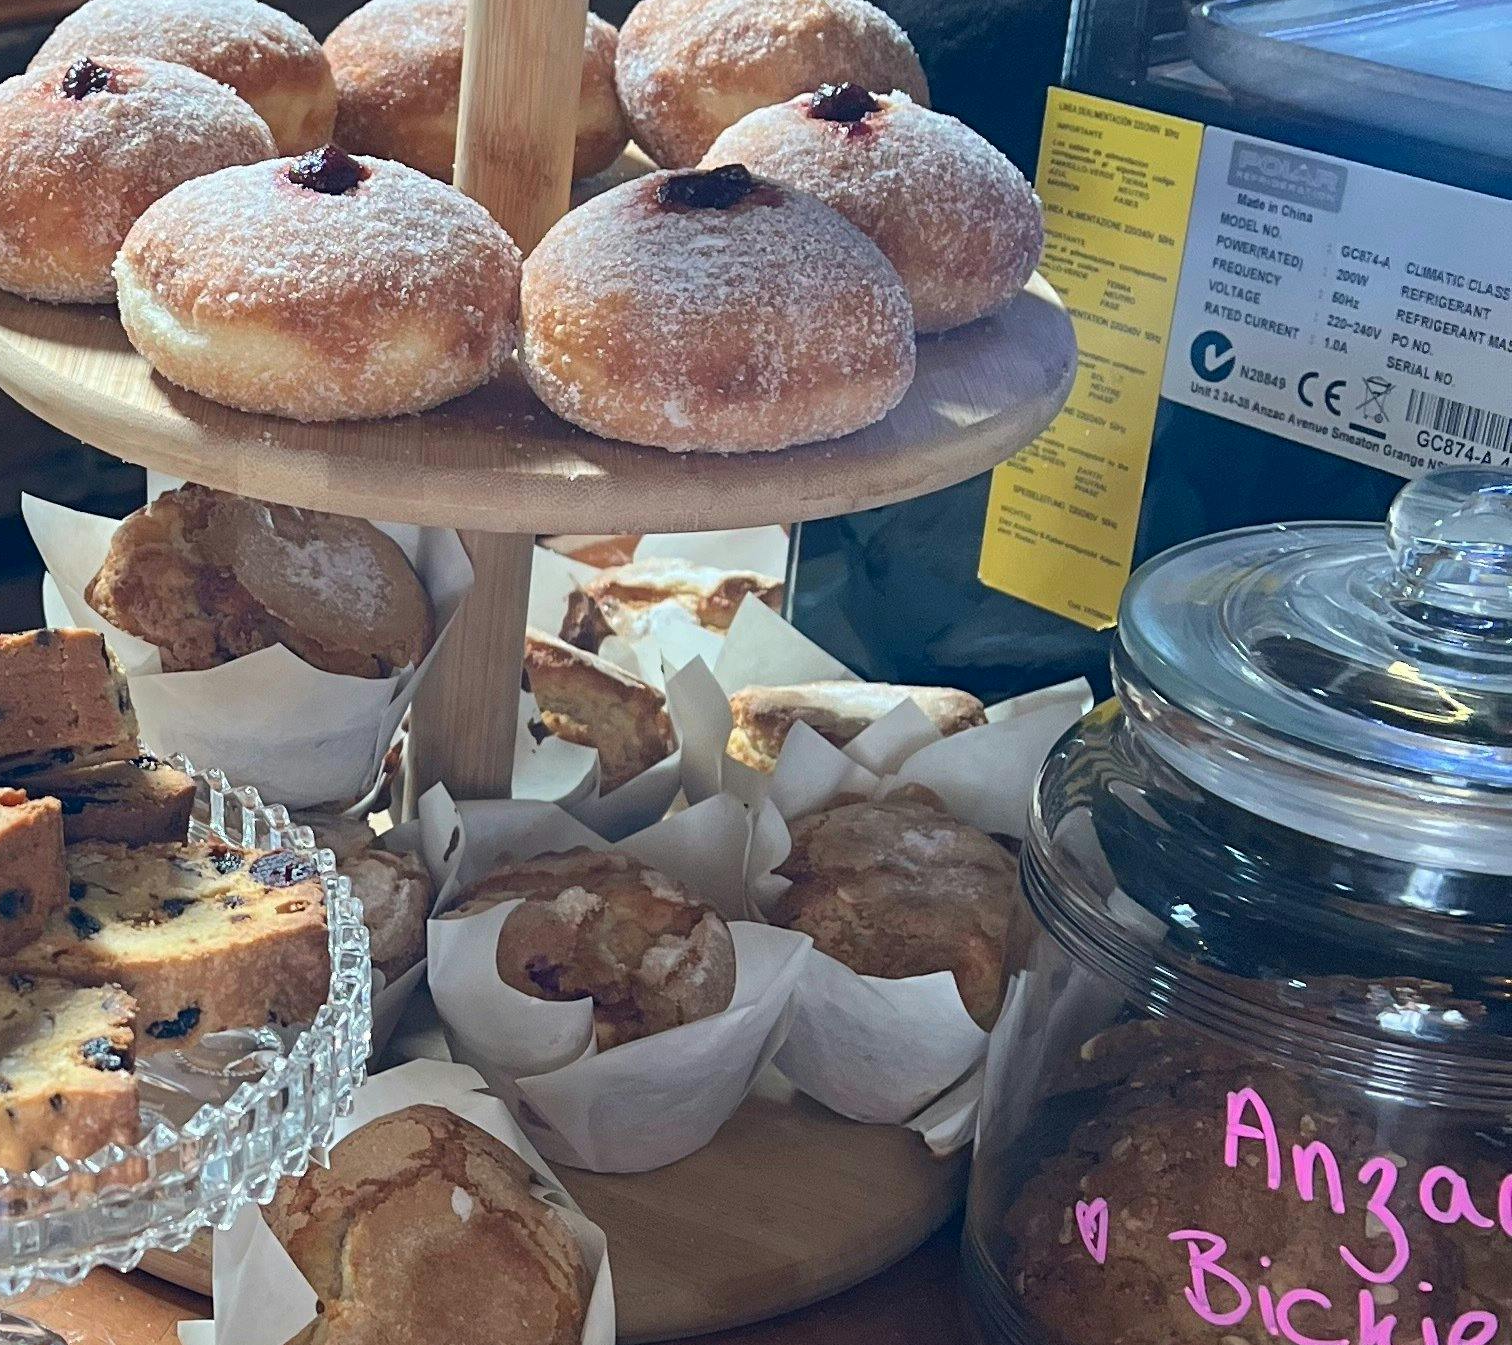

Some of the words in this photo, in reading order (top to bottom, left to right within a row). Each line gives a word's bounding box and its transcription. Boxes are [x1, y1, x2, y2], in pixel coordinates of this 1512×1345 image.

[1237, 193, 1265, 210] Made
[1268, 202, 1277, 213] in
[1282, 205, 1313, 223] China
[1216, 234, 1304, 272] POWER(RATED)
[1400, 285, 1492, 320] REFRIGERANT
[1220, 212, 1258, 233] MODEL
[1342, 246, 1390, 269] GC874-A
[1406, 262, 1465, 288] CLIMATIC
[1468, 278, 1511, 301] CLASS
[1203, 300, 1242, 323] RATED
[1243, 312, 1300, 340] CURRENT
[1386, 355, 1430, 380] SERIAL
[1209, 278, 1262, 305] VOLTAGE
[1390, 332, 1409, 348] PO
[1212, 257, 1283, 287] FREQUENCY
[1395, 308, 1486, 345] REFRIGERANT
[1190, 380, 1210, 396] Unit
[1287, 413, 1329, 435] Avenue
[1331, 426, 1380, 453] Smeaton
[1383, 444, 1424, 468] Grange
[1416, 430, 1492, 464] GC874-A
